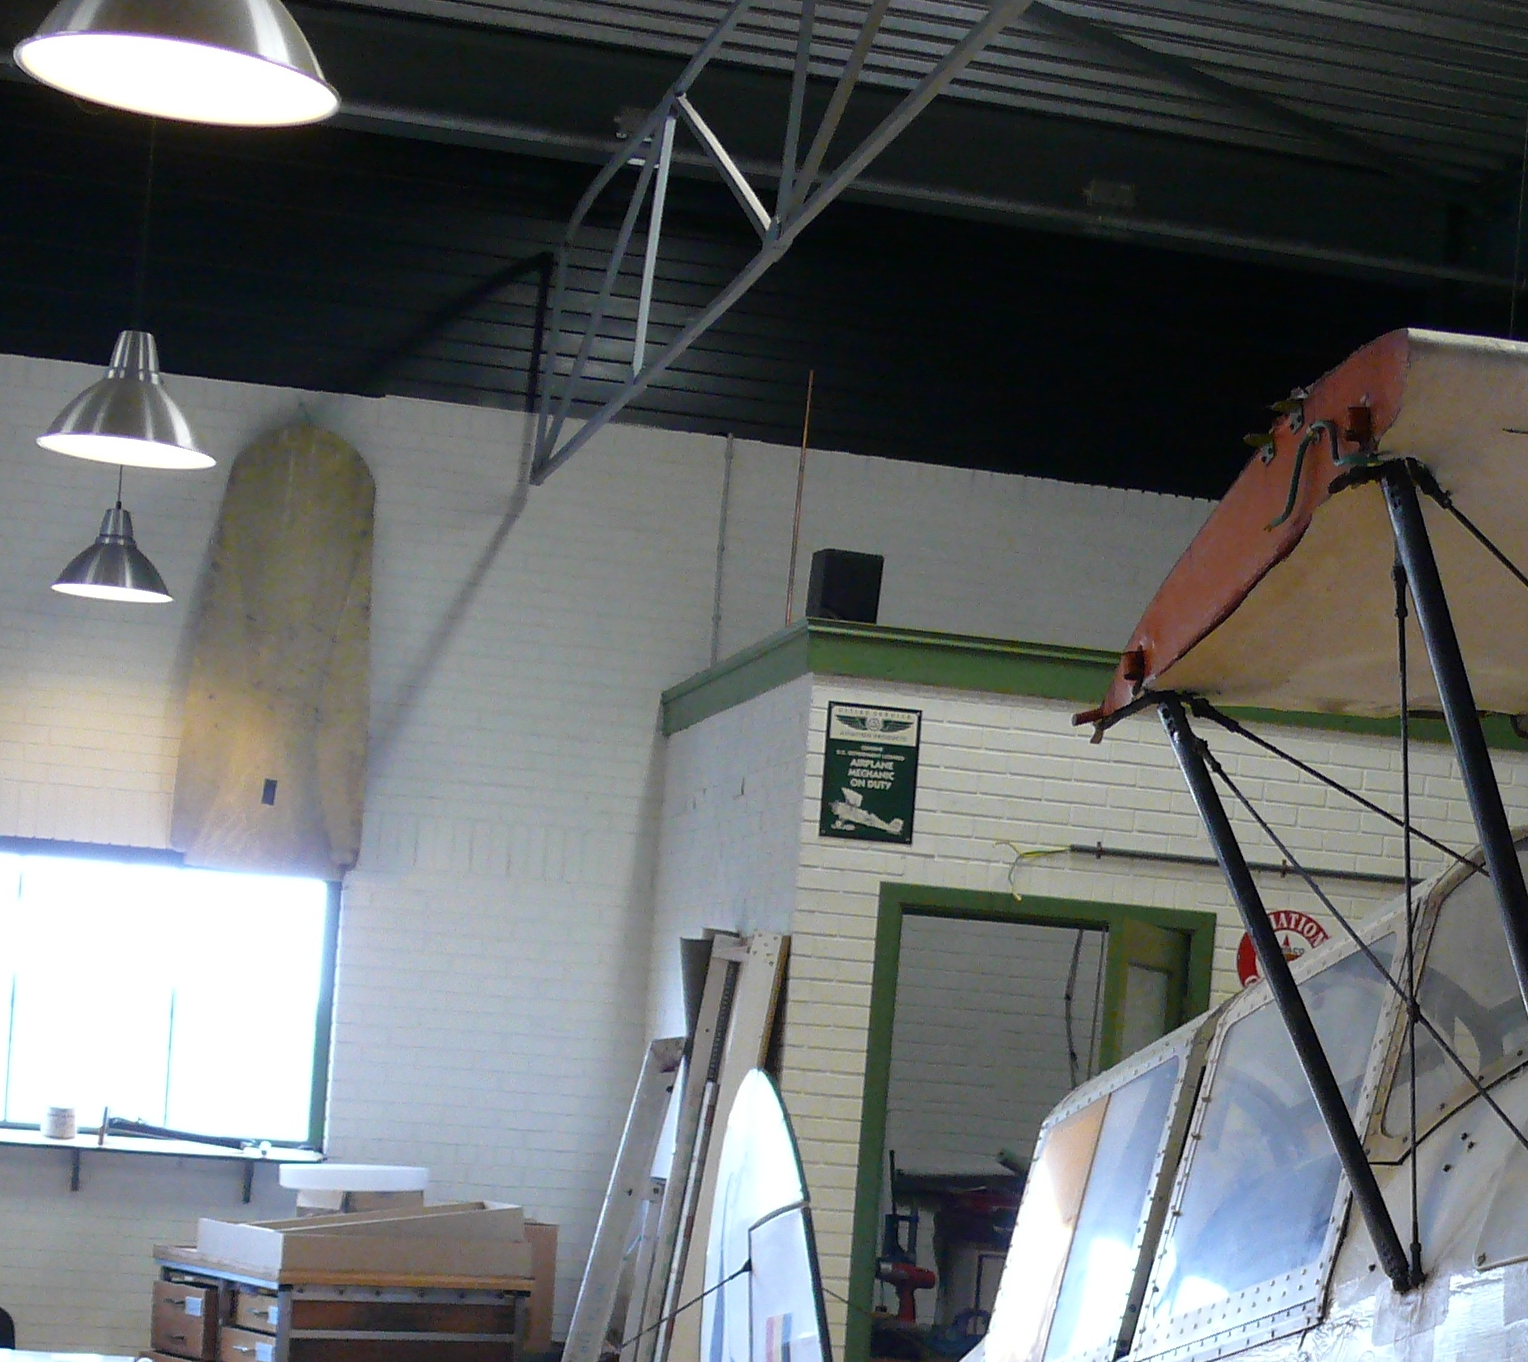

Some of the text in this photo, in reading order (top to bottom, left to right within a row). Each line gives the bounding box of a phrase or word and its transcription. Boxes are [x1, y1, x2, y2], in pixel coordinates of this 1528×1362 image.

[849, 758, 894, 770] AIRPLANE
[847, 768, 895, 780] MECHANIC
[849, 778, 892, 790] ON DUTY
[1268, 911, 1328, 949] IATION
